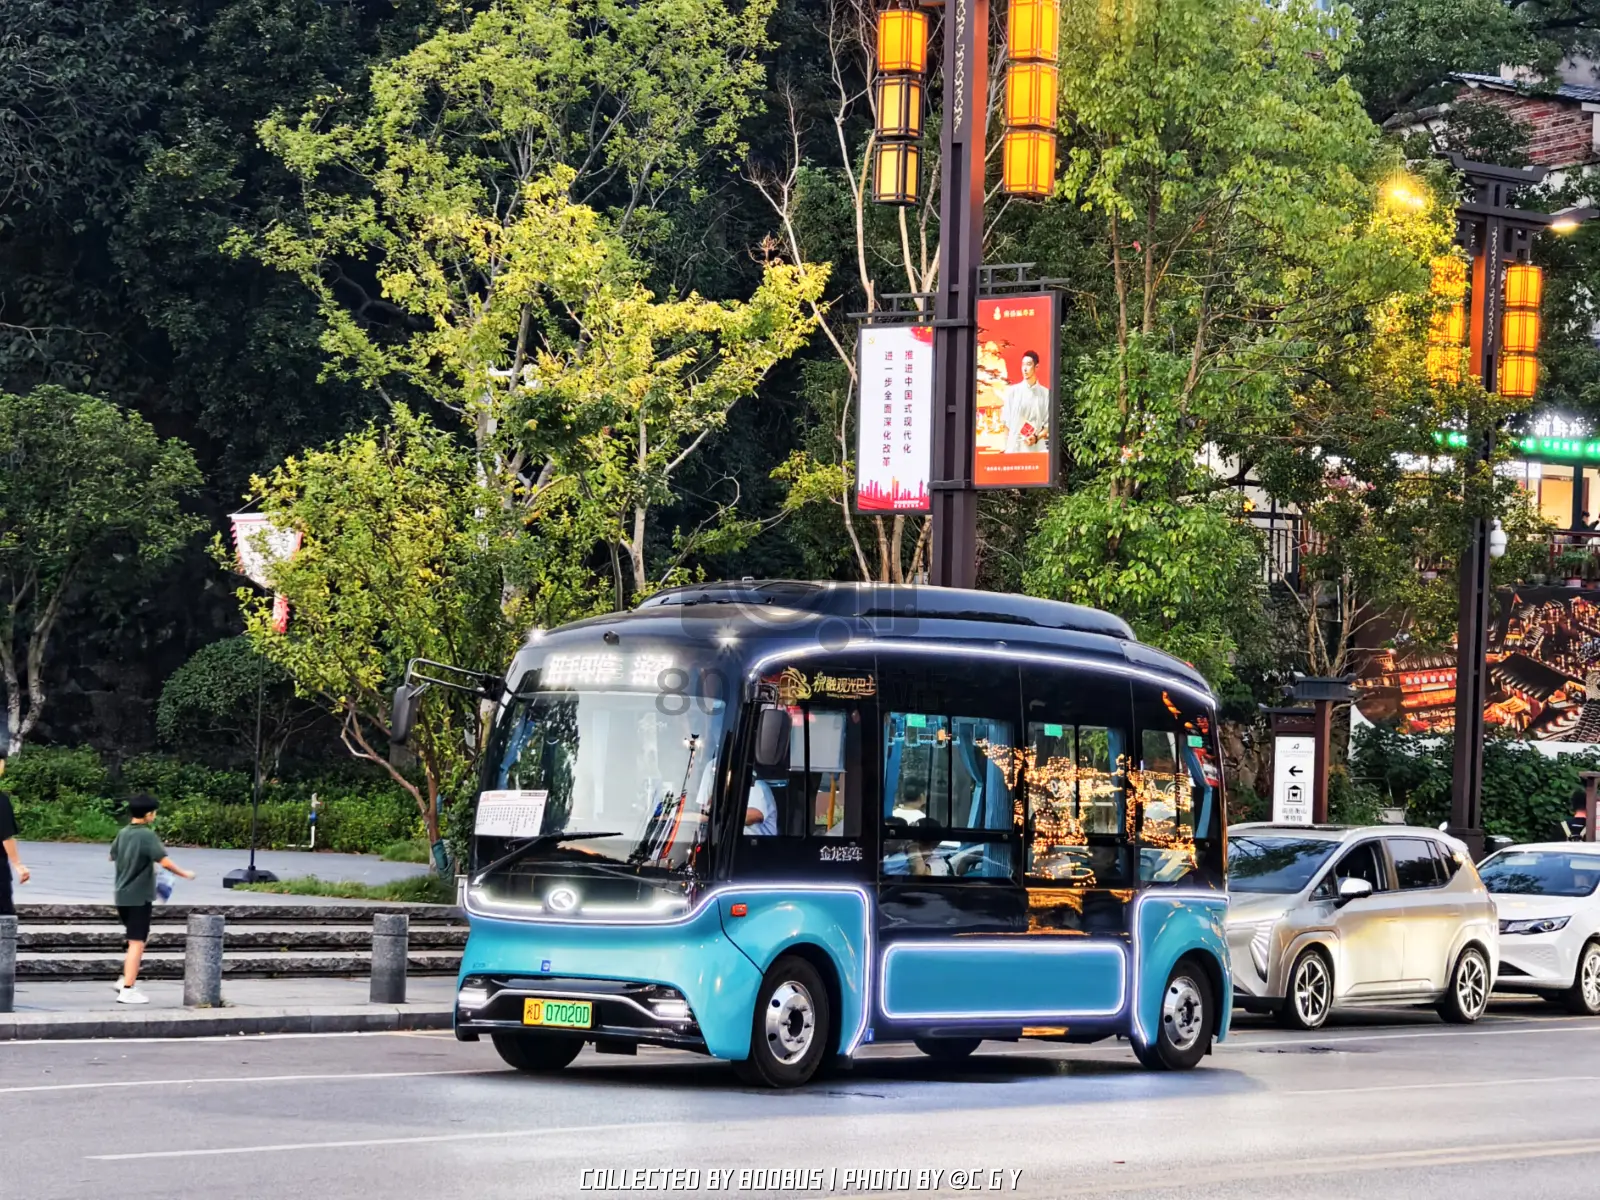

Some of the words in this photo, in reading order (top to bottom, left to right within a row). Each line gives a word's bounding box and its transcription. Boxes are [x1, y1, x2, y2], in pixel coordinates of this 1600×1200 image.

[882, 351, 893, 467] 进一步全面深化改革
[903, 350, 913, 454] 推进中国式现代化
[811, 671, 876, 696] 祝融观光巴士
[820, 845, 862, 861] 金龙客车
